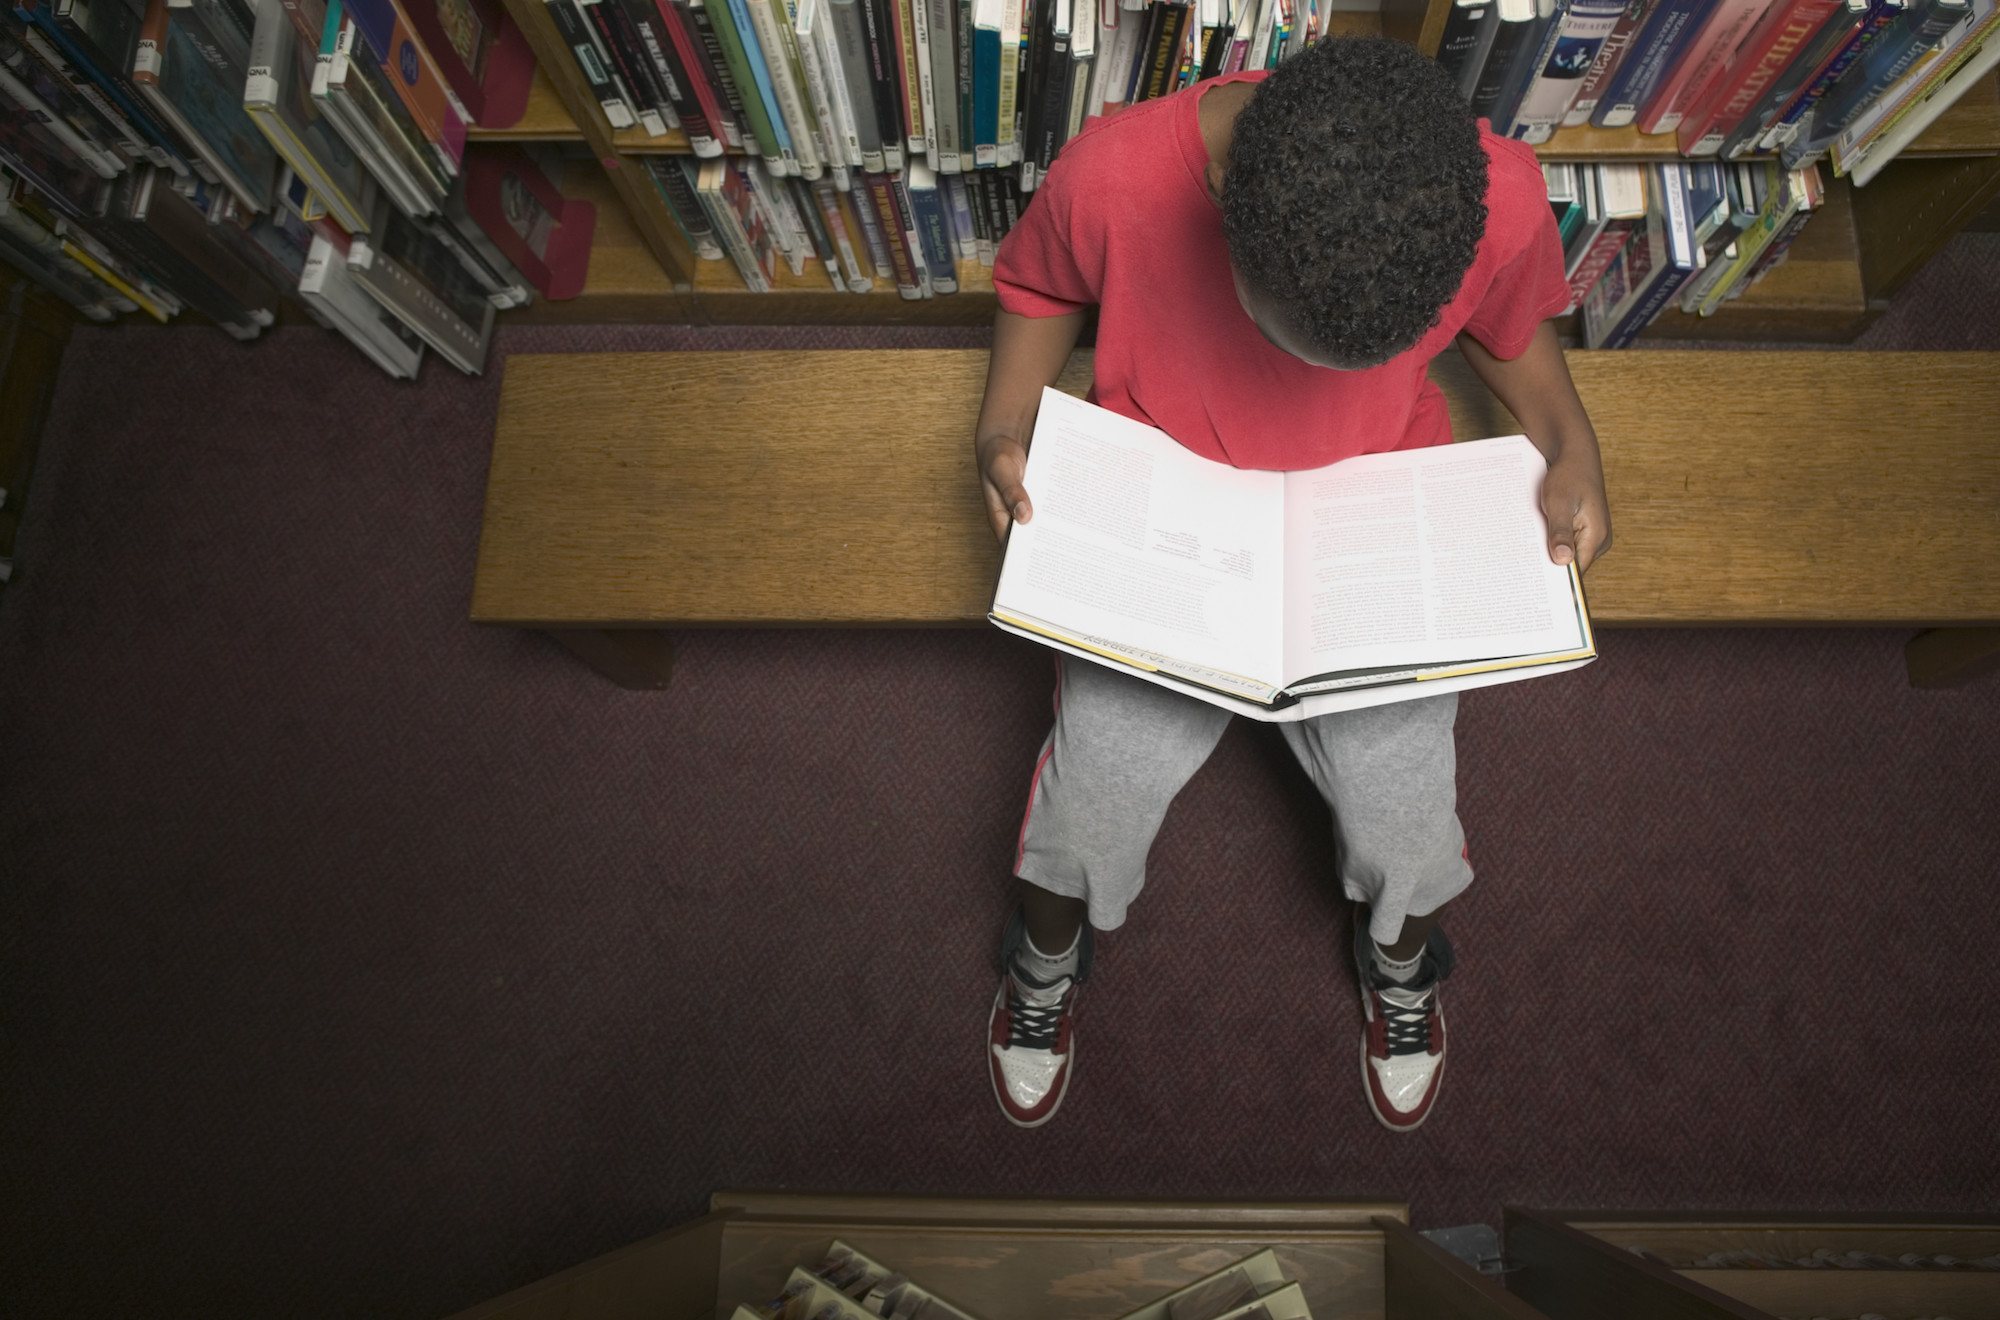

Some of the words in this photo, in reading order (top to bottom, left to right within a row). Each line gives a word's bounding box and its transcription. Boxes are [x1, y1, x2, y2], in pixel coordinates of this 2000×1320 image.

[249, 67, 267, 77] QNA
[1586, 30, 1632, 91] Theatre
[1724, 22, 1812, 114] THEATRE
